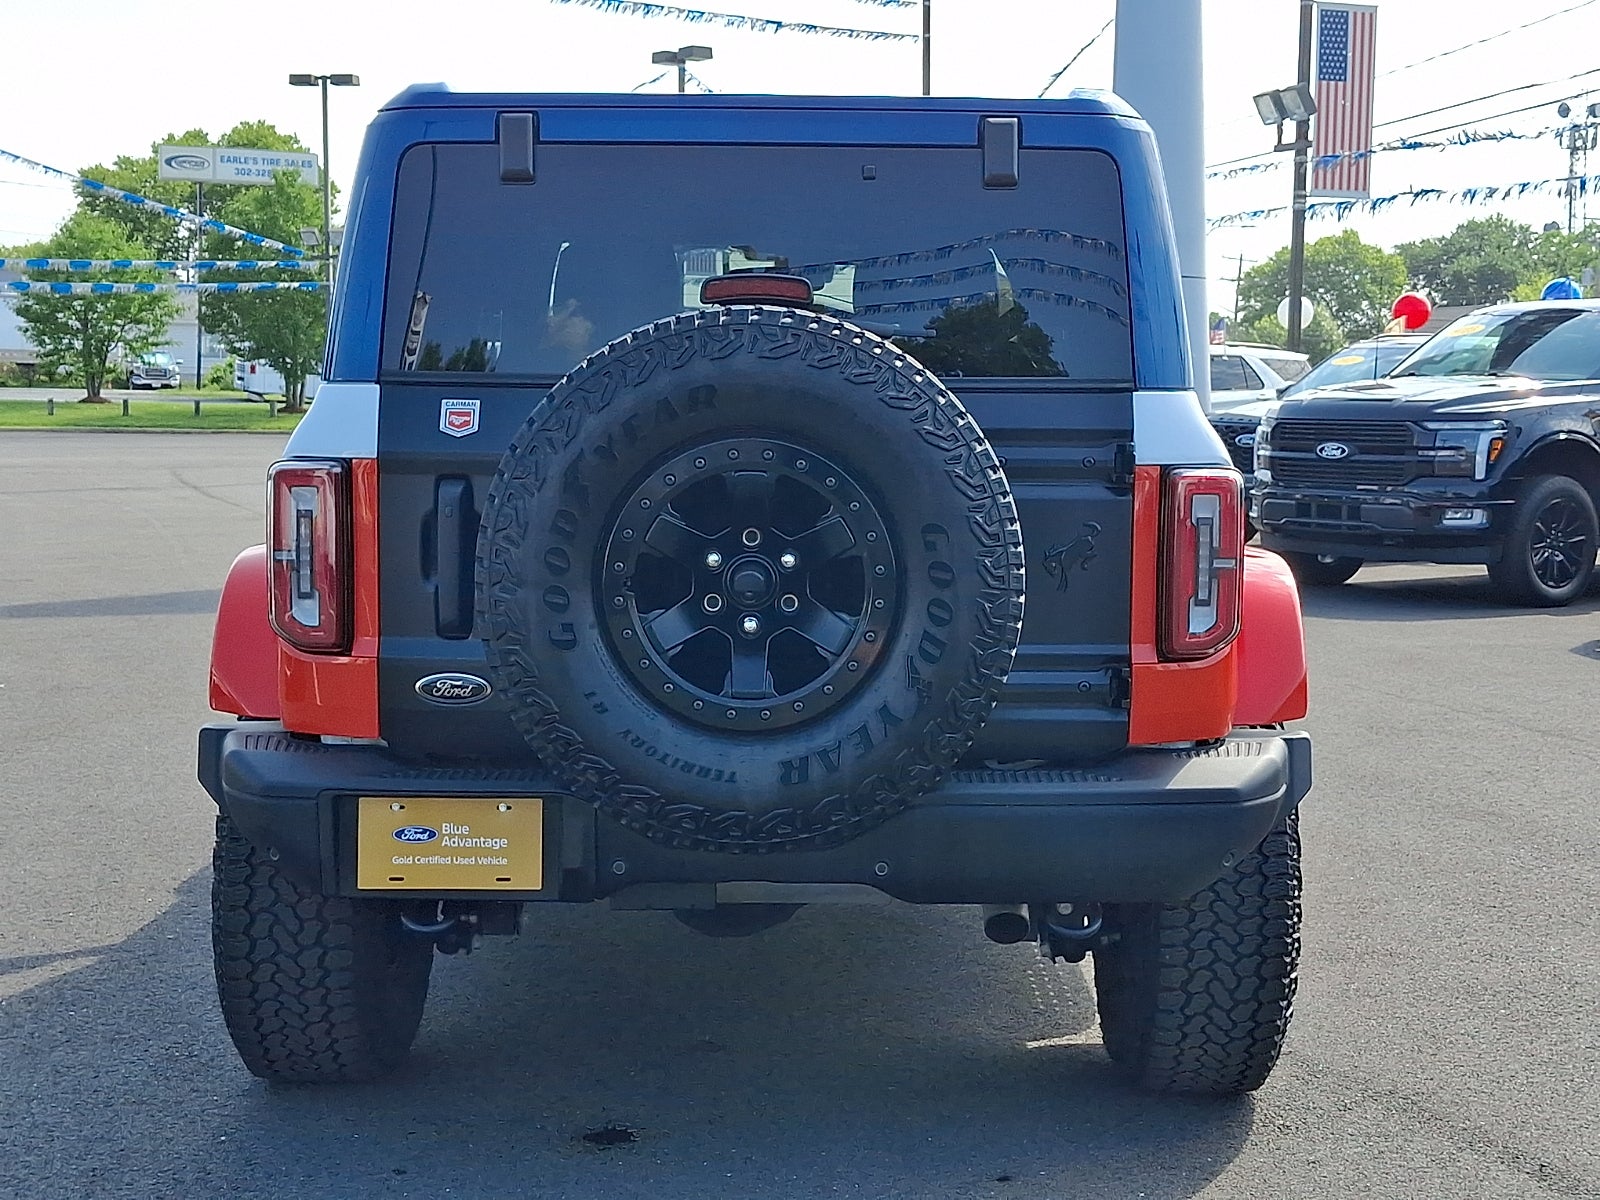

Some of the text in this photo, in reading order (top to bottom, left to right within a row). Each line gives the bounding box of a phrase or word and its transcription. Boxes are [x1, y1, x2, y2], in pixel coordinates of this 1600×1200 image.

[220, 155, 258, 166] EARLE'S
[261, 157, 281, 167] TIRE
[445, 400, 477, 408] CARMAN
[432, 679, 476, 697] Ford
[616, 728, 738, 784] TERRITORY
[401, 828, 430, 841] Ford
[442, 822, 470, 835] Blue
[441, 836, 508, 850] Advantage
[391, 855, 508, 865] Gold Certified Used Vehicle
